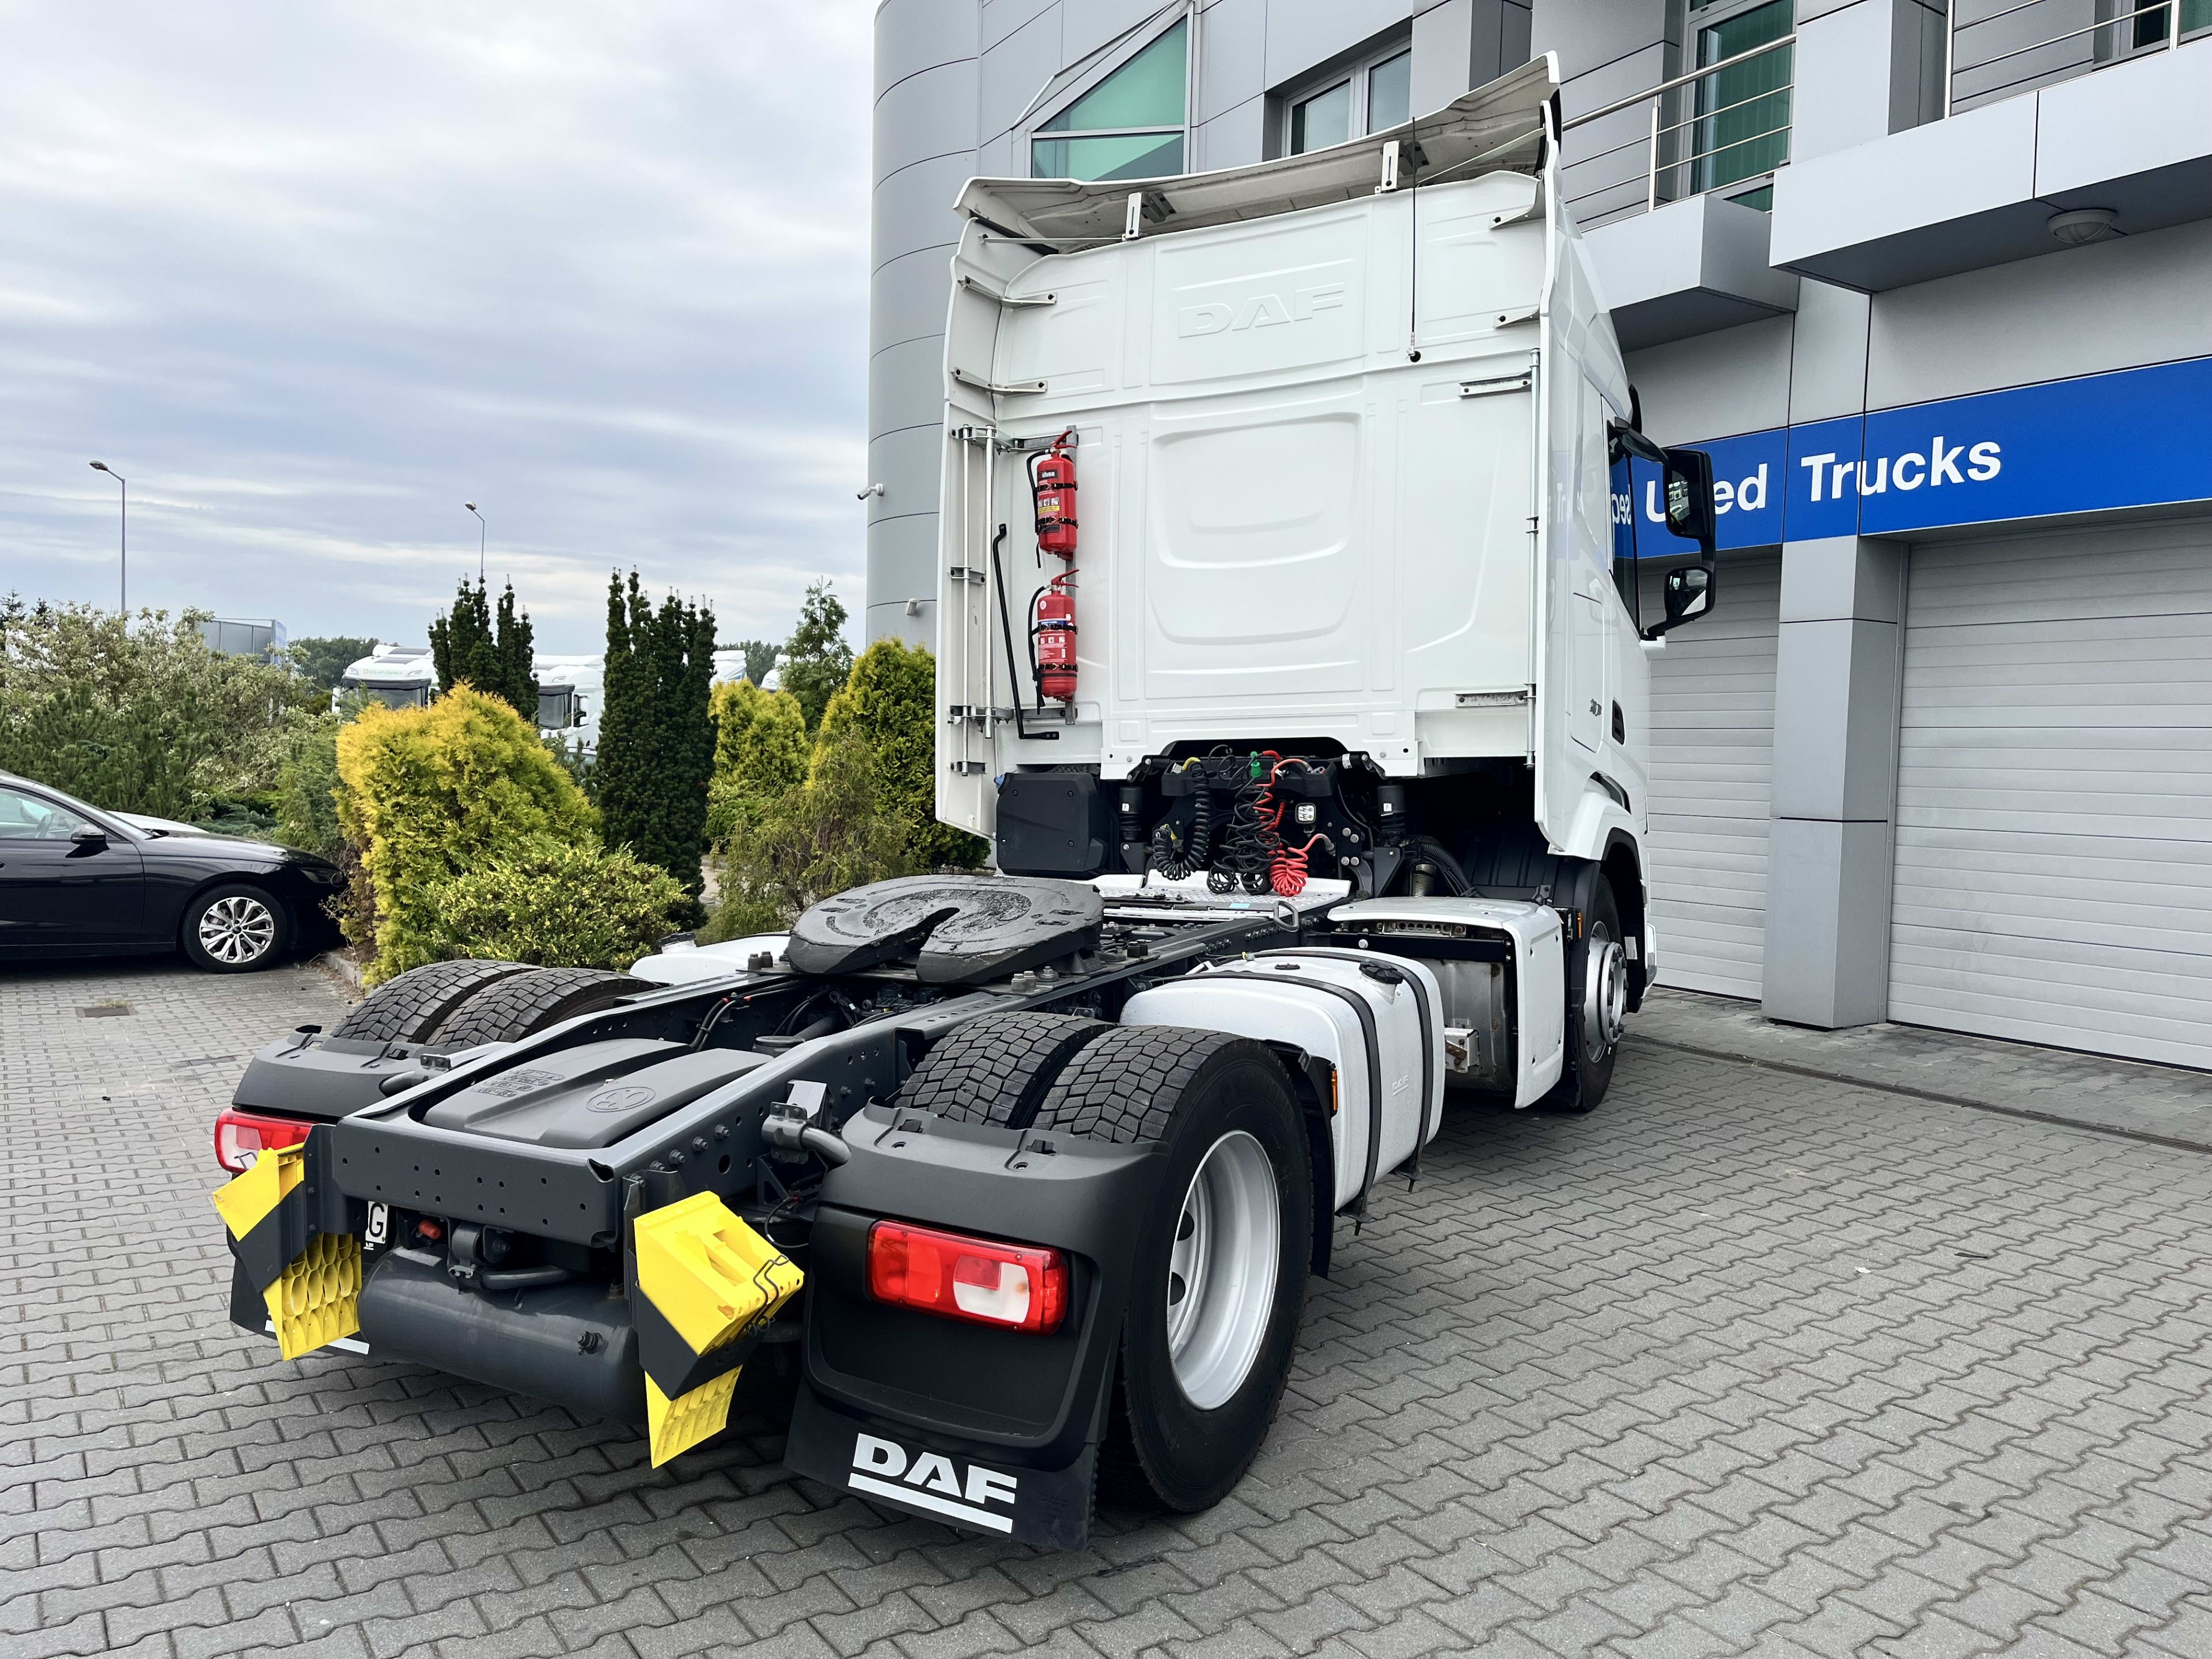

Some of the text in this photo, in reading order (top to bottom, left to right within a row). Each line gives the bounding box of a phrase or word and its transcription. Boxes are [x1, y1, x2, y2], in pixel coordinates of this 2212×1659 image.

[1179, 282, 1344, 338] DAF
[1646, 463, 1767, 523] Ued
[1801, 435, 2002, 502] Trucks
[853, 1432, 1017, 1505] DAF
